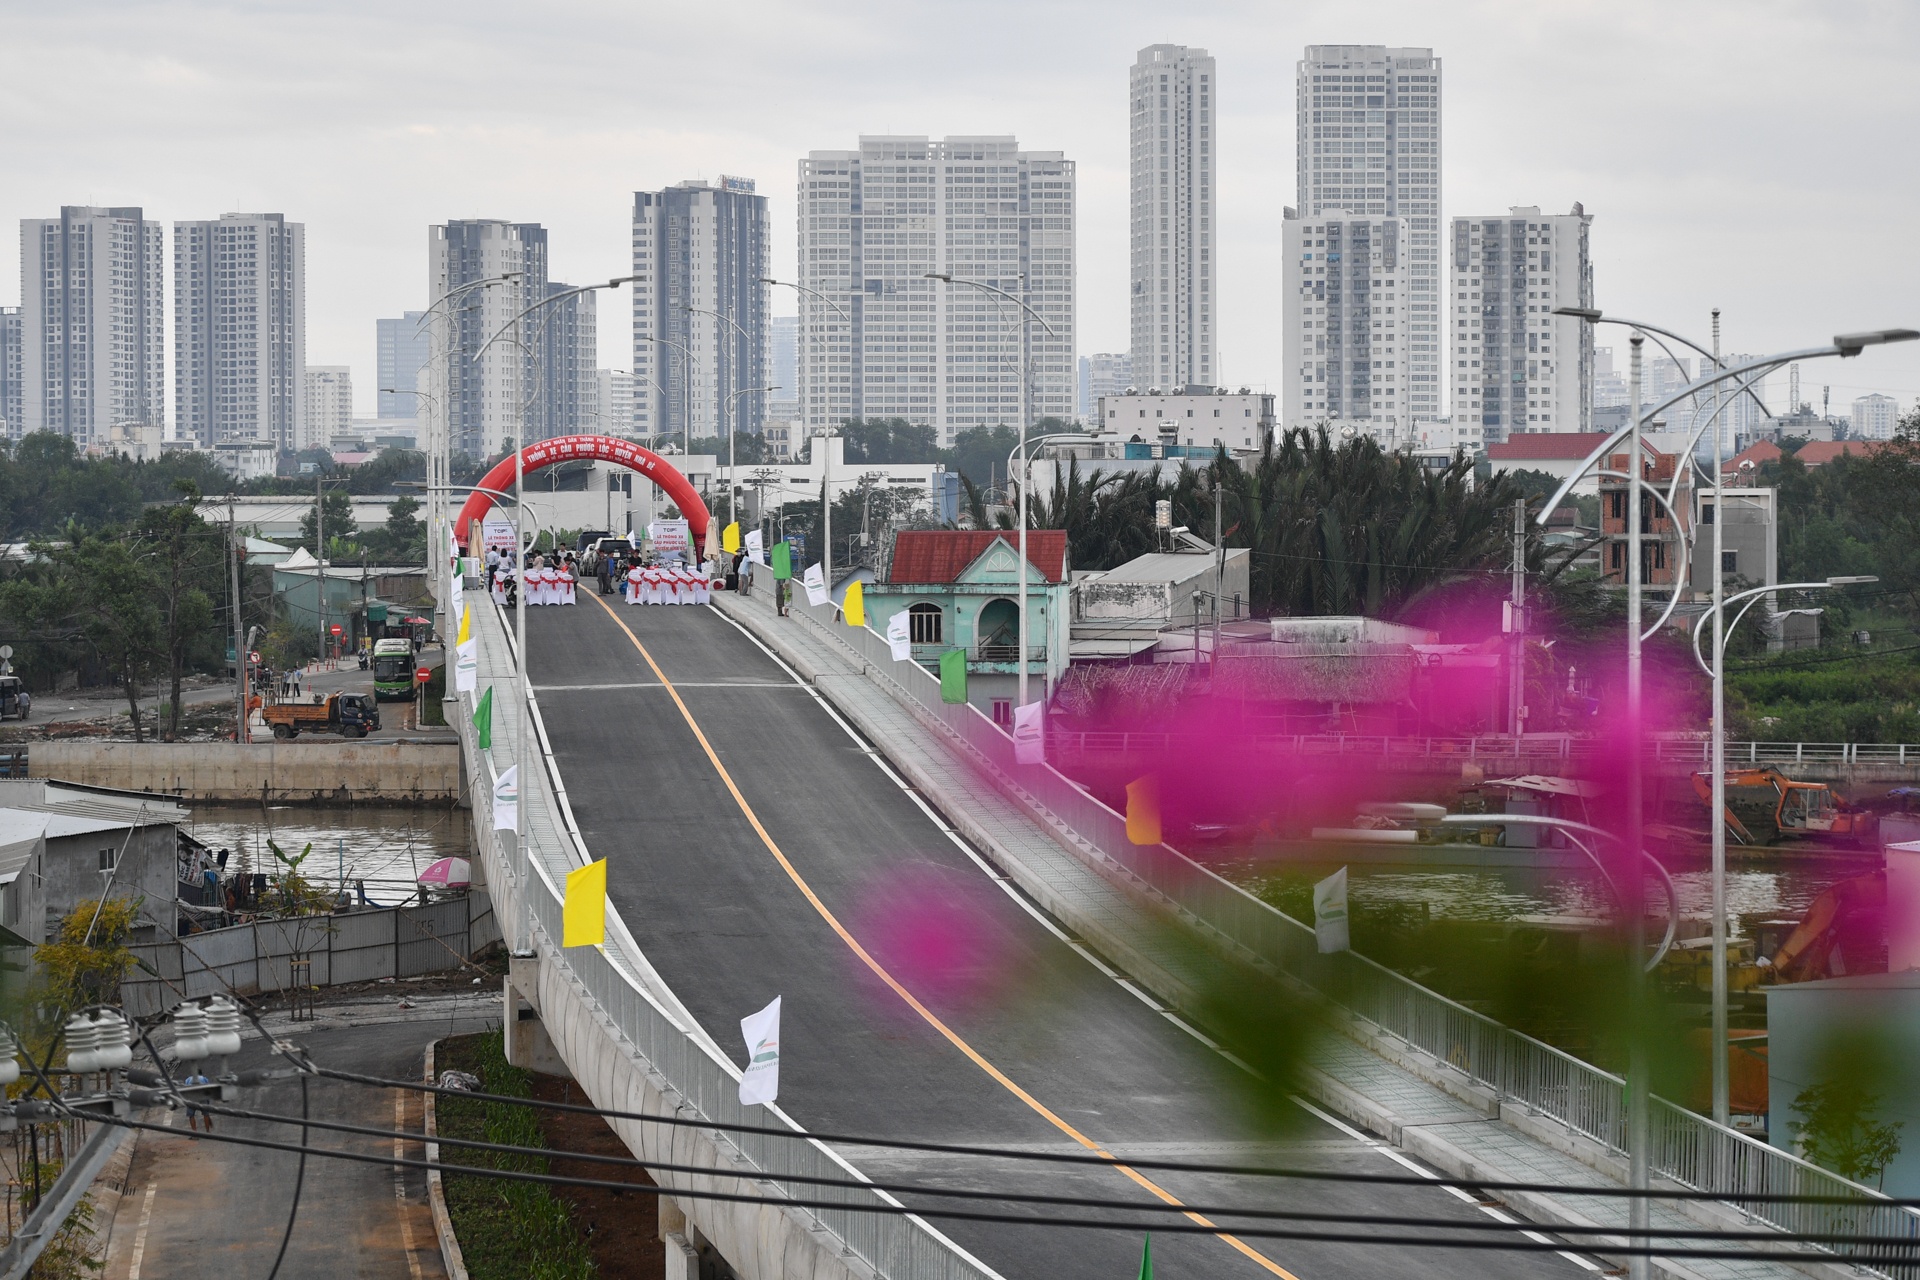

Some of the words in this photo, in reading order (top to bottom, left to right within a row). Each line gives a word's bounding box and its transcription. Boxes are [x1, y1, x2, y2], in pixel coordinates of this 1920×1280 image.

[527, 450, 546, 463] THÔNG
[549, 446, 557, 456] XE
[598, 444, 610, 454] LỘC
